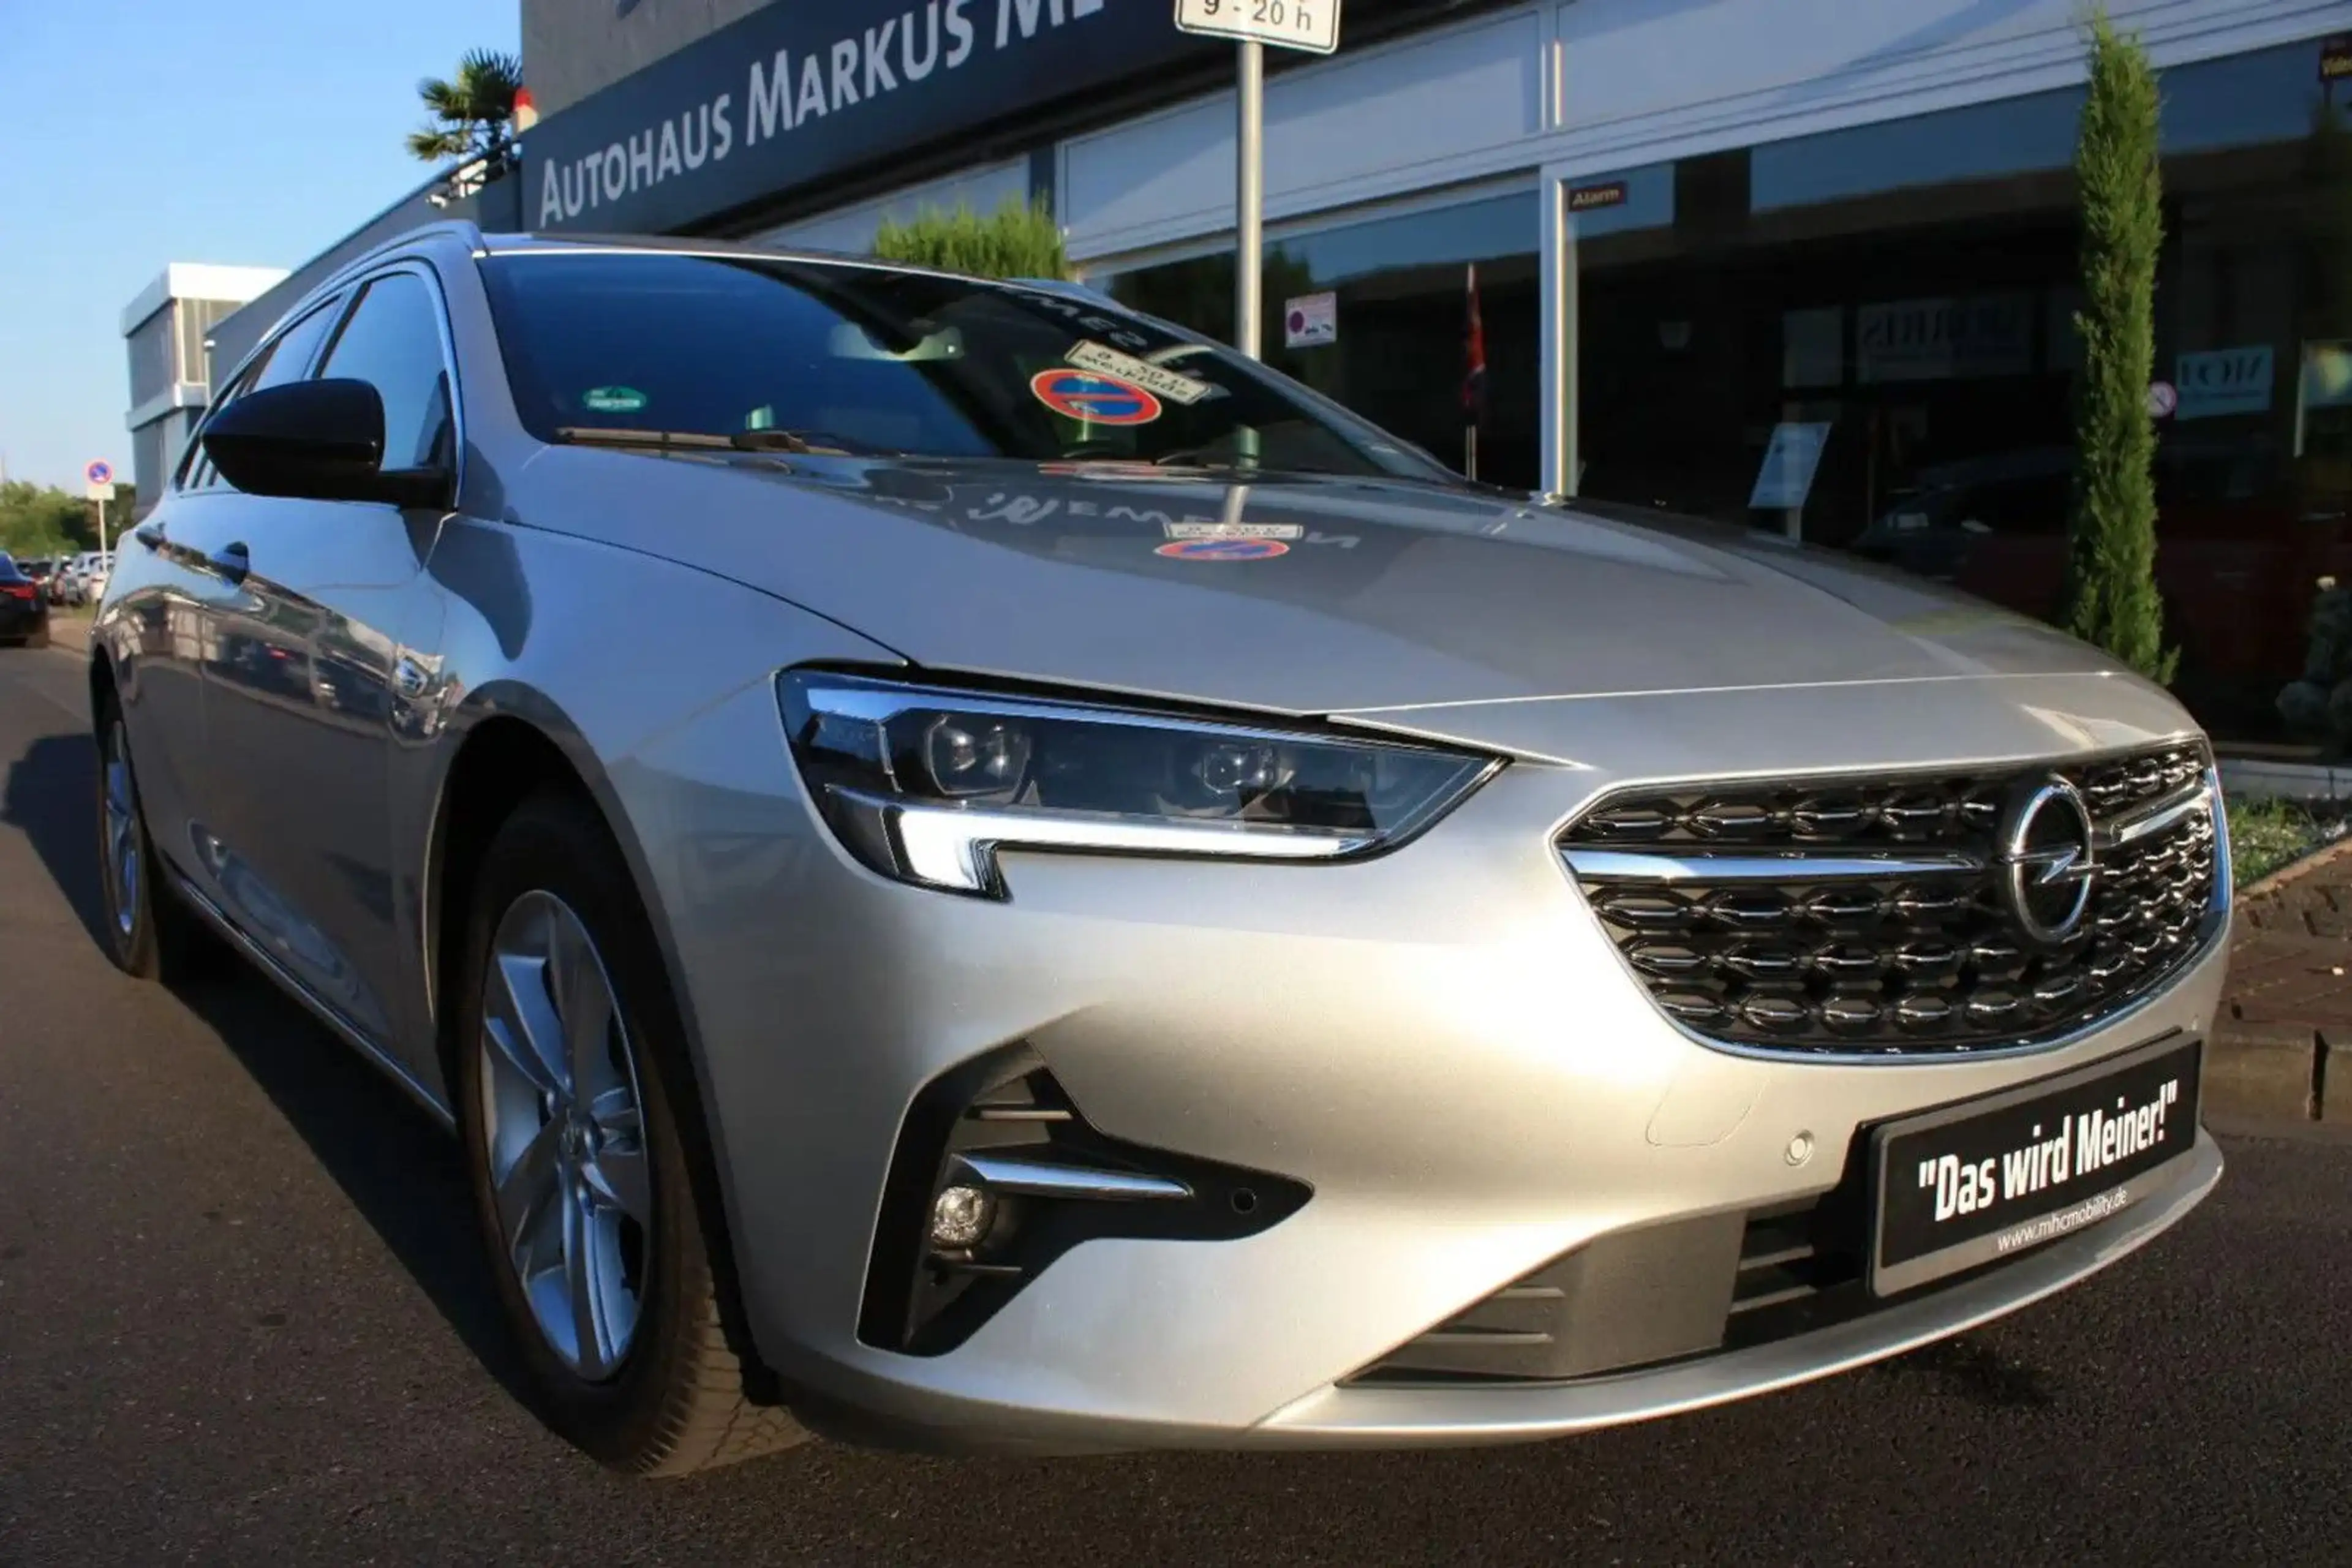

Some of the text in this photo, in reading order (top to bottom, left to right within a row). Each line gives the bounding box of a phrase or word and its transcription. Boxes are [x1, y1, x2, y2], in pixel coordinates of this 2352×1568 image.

[1252, 0, 1284, 25] 20
[1296, 5, 1311, 31] h
[1572, 188, 1621, 207] Alarm
[1918, 1079, 2177, 1222] "Das wird Meiner!"
